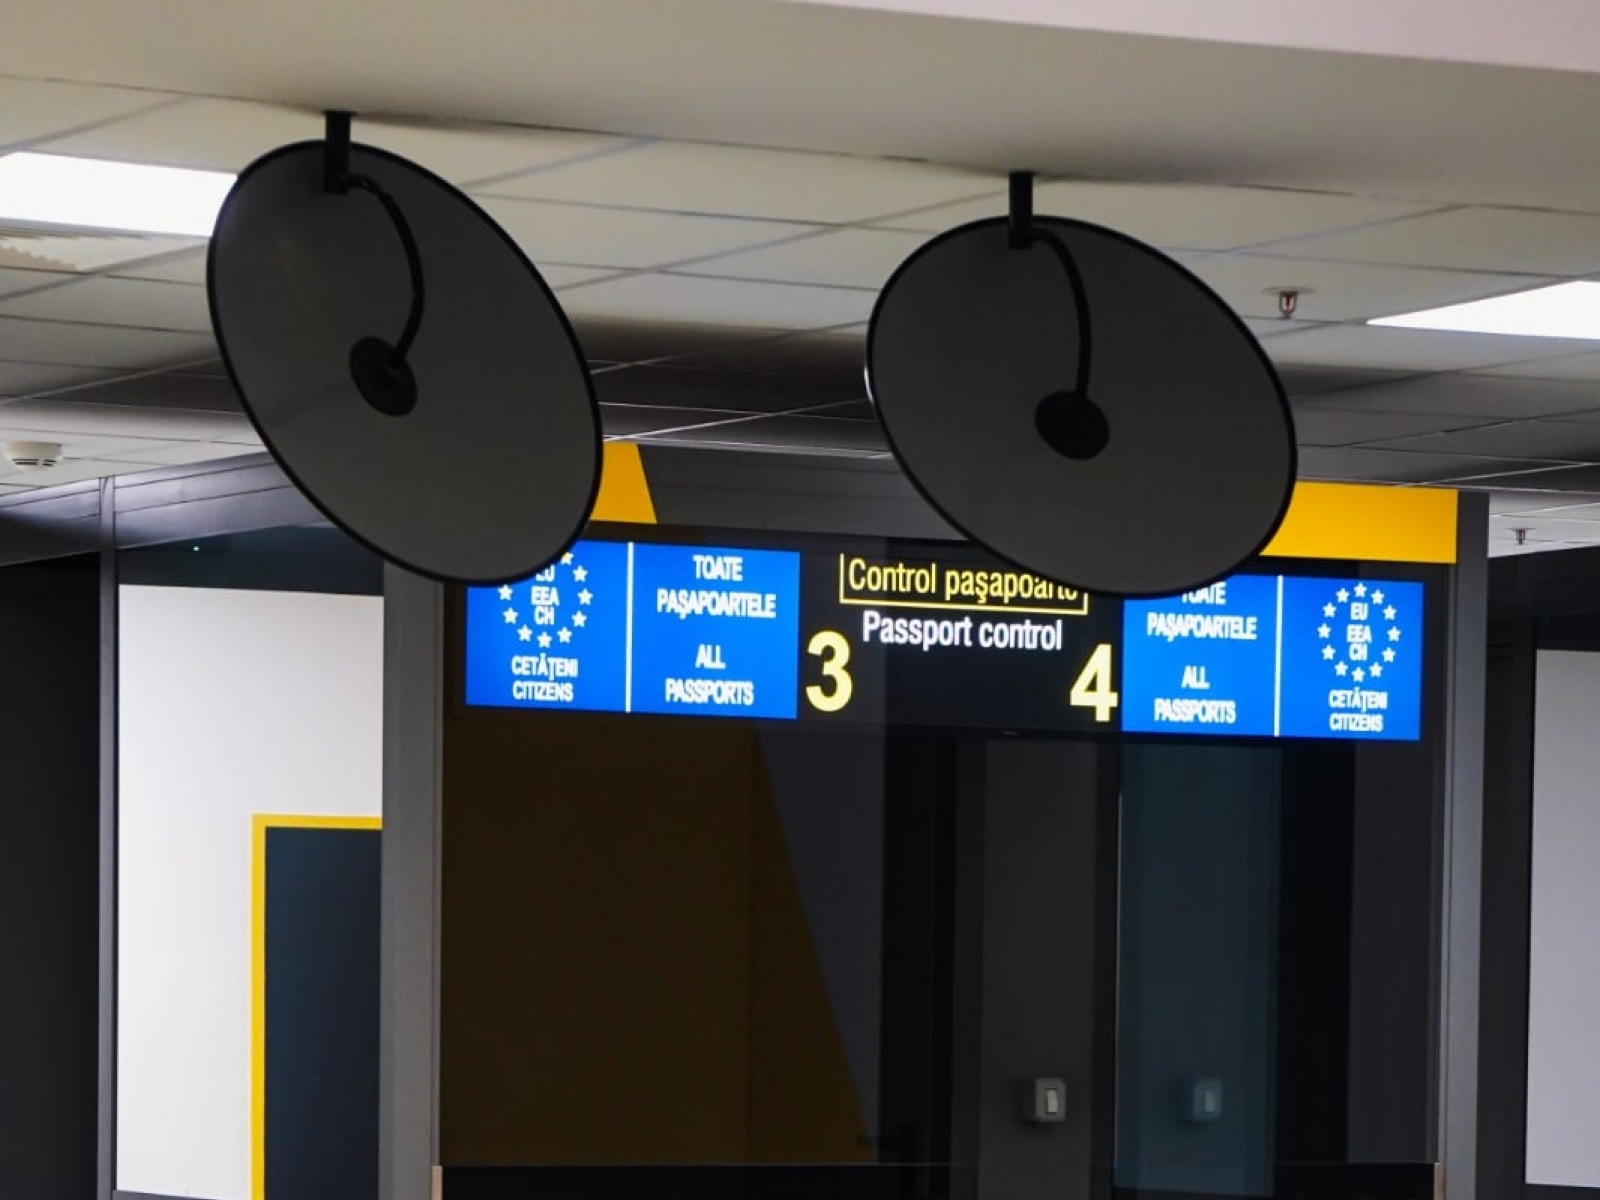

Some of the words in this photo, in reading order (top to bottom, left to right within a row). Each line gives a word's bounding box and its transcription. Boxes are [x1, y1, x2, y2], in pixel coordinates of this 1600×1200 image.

[692, 555, 743, 581] TOATE
[849, 558, 936, 593] Control
[531, 585, 559, 606] EEA
[534, 605, 555, 625] CH
[1351, 602, 1369, 621] EU
[862, 610, 973, 651] Passport
[979, 619, 1063, 650] control
[1346, 624, 1372, 643] EEA
[695, 644, 726, 669] ALL
[1349, 643, 1368, 661] CH
[806, 631, 853, 712] 3
[1069, 644, 1118, 722] 4
[1181, 665, 1210, 689] ALL
[512, 681, 574, 702] CITIZENS
[665, 678, 754, 706] PASSPORTS
[1154, 698, 1236, 724] PASSPORTS
[1329, 713, 1383, 732] CITIZENS
